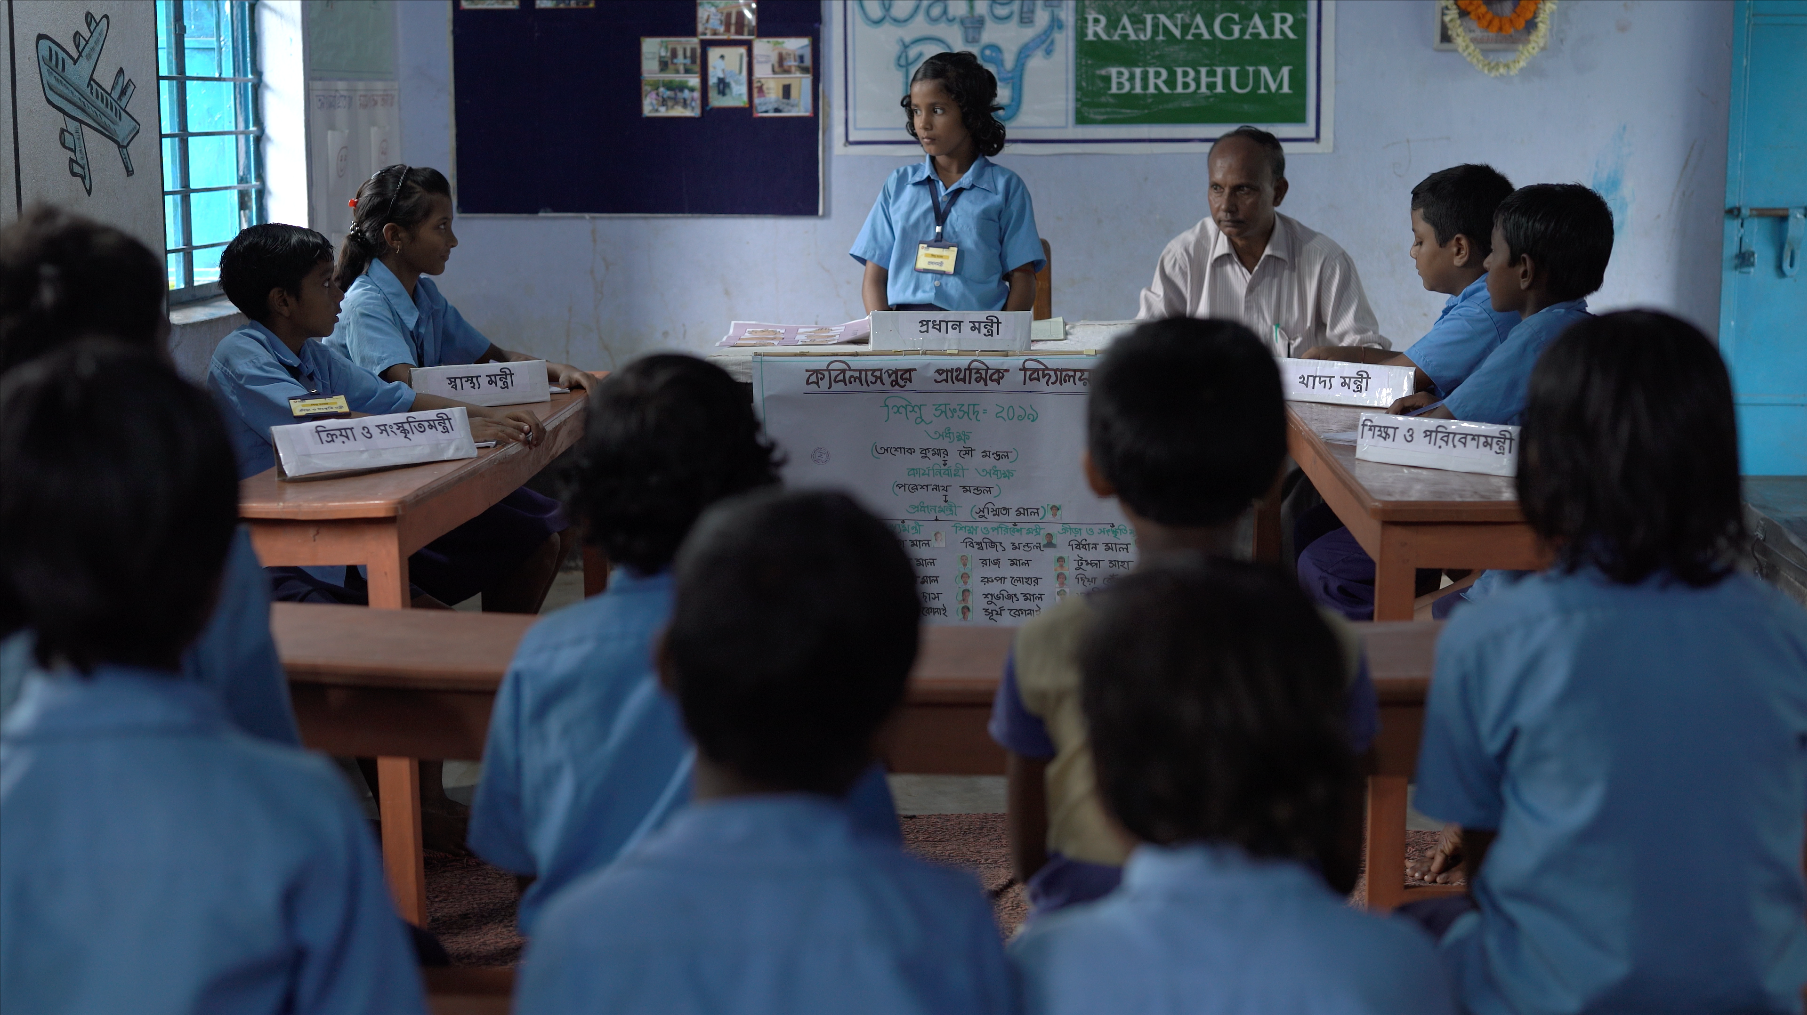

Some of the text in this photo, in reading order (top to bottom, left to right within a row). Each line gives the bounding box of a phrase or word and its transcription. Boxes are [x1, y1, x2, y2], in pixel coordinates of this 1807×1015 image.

[1084, 12, 1298, 41] RAJNAGAR
[1107, 66, 1293, 94] BIRBHUM
[918, 315, 1002, 338] প্রধান মন্ত্রী
[446, 367, 515, 391] স্বাস্থ্য মন্ত্রী
[805, 359, 917, 389] কবিলাসপুর
[934, 359, 1010, 387] প্রাথমিক
[1298, 370, 1371, 393] খাদ্য মন্ত্রী
[880, 396, 933, 425] শিশু
[995, 404, 1039, 422] ২০১৯
[315, 412, 455, 445] ক্রিয়া ও সংস্কৃতিমন্ত্রী
[925, 426, 972, 444] অধ্যক্ষ
[1360, 419, 1515, 456] শিক্ষা ও পরিবেশমন্ত্রী
[919, 447, 949, 461] কুমার
[975, 466, 1016, 480] অধ্যক্ষ
[1086, 527, 1095, 535] ও
[1007, 557, 1032, 568] মাল
